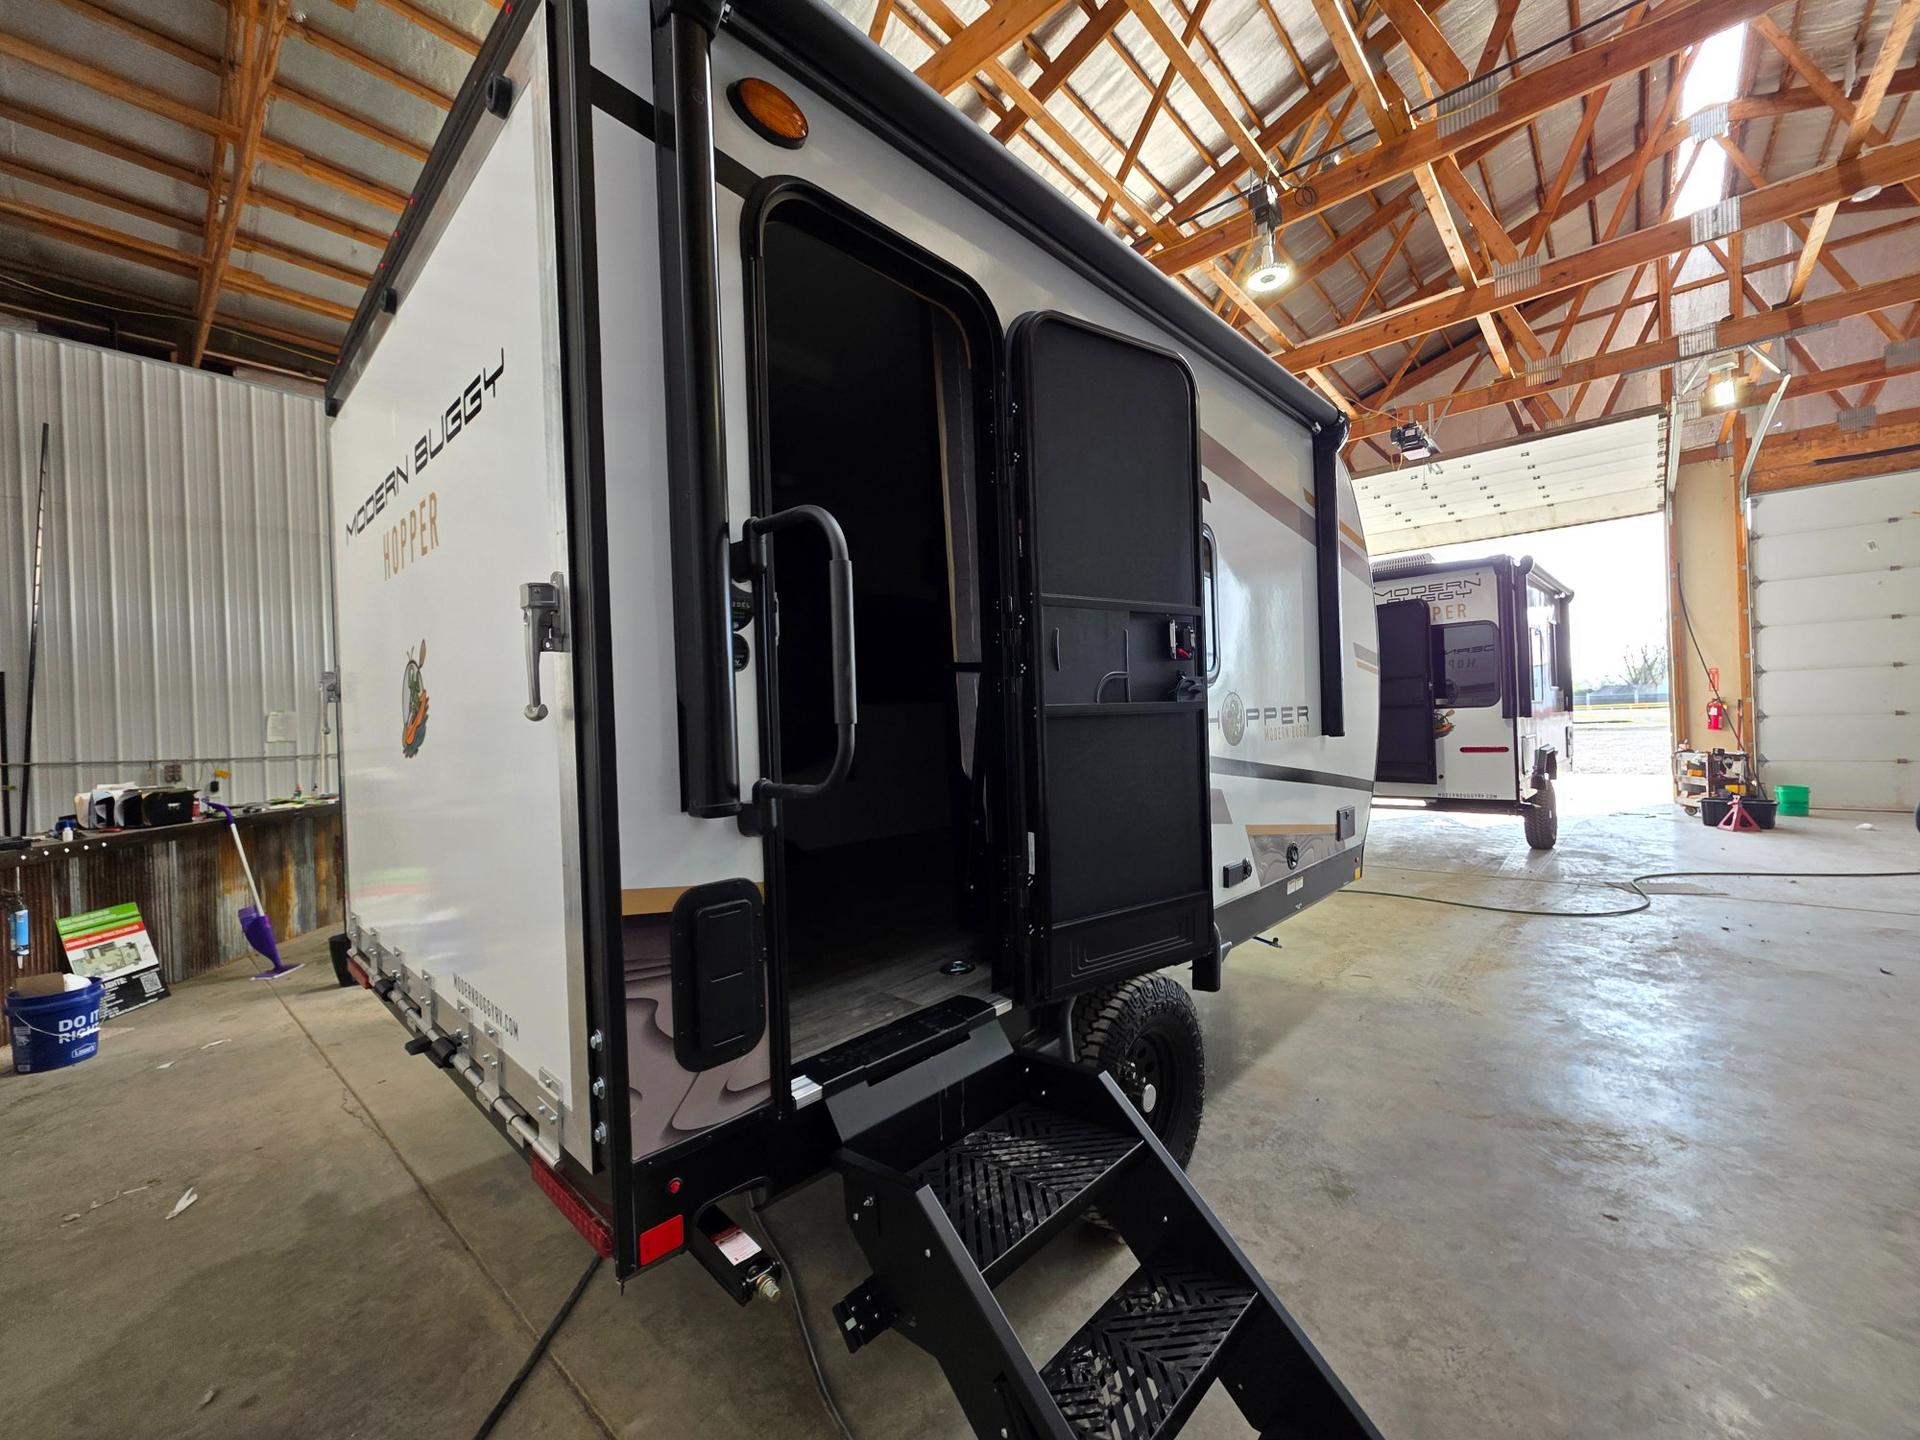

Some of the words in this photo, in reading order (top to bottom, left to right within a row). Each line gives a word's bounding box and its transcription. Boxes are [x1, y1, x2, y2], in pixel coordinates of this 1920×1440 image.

[346, 455, 409, 546] MODERN
[414, 347, 504, 475] BUGGY
[383, 491, 439, 582] HOPPER
[1374, 578, 1481, 598] MODERN
[1432, 603, 1467, 621] PER
[59, 1015, 86, 1032] DO
[90, 1009, 100, 1023] IT
[453, 972, 519, 1041] MODERNBUGGYRV.COM
